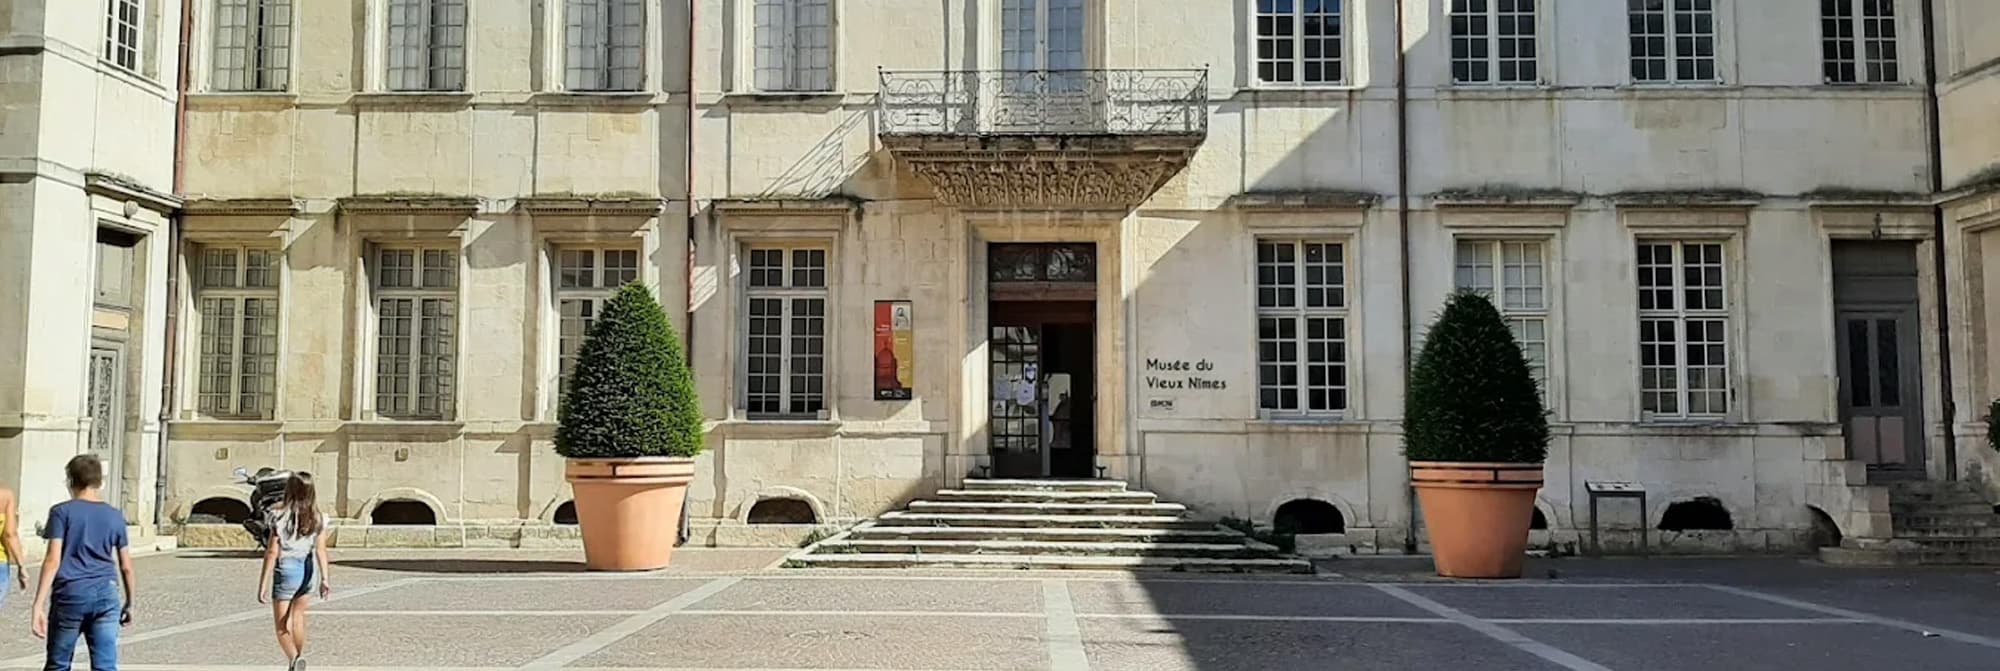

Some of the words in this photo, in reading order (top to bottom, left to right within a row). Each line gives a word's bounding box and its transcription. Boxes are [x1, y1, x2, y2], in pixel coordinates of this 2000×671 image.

[1146, 358, 1190, 371] Musée
[1196, 358, 1213, 371] du
[1146, 376, 1183, 389] Vieux
[1188, 376, 1226, 389] Nîmes
